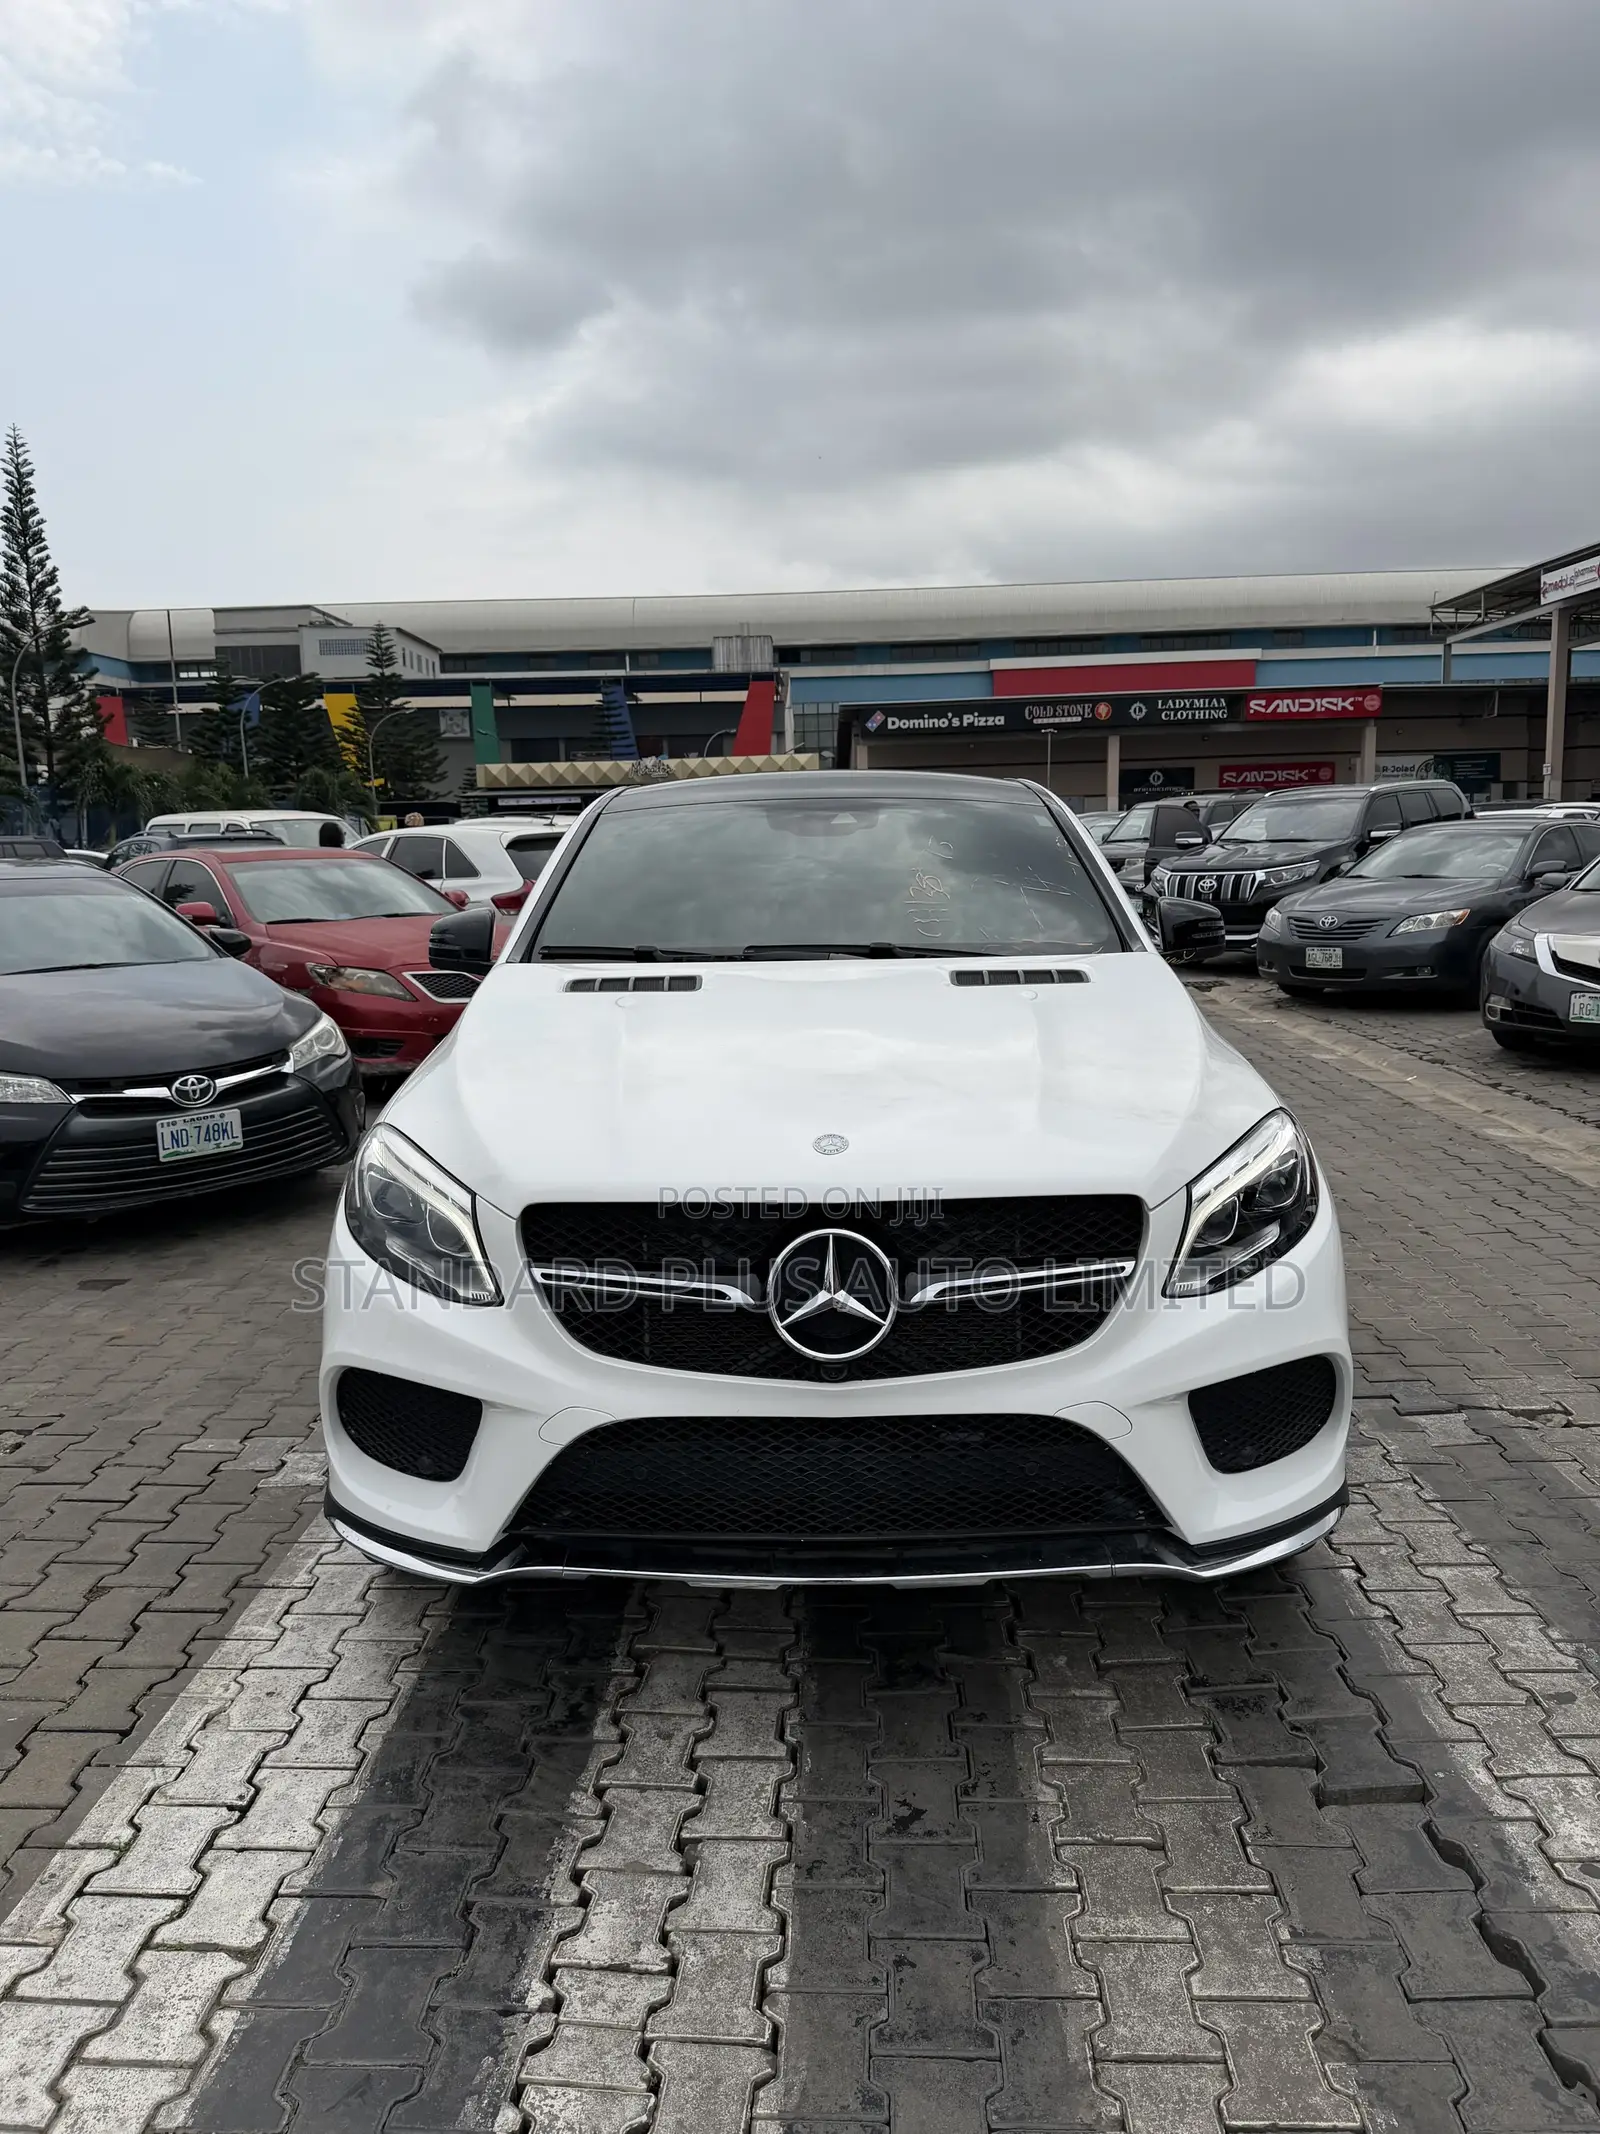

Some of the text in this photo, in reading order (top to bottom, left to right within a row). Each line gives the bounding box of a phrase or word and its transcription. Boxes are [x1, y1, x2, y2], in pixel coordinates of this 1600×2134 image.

[1025, 705, 1054, 720] COLD
[1055, 703, 1093, 718] STONE
[1249, 697, 1355, 713] SANDISK
[887, 711, 1005, 730] Domino's Pizza
[1161, 709, 1228, 720] CLOTHING
[1223, 769, 1309, 783] SANDISK
